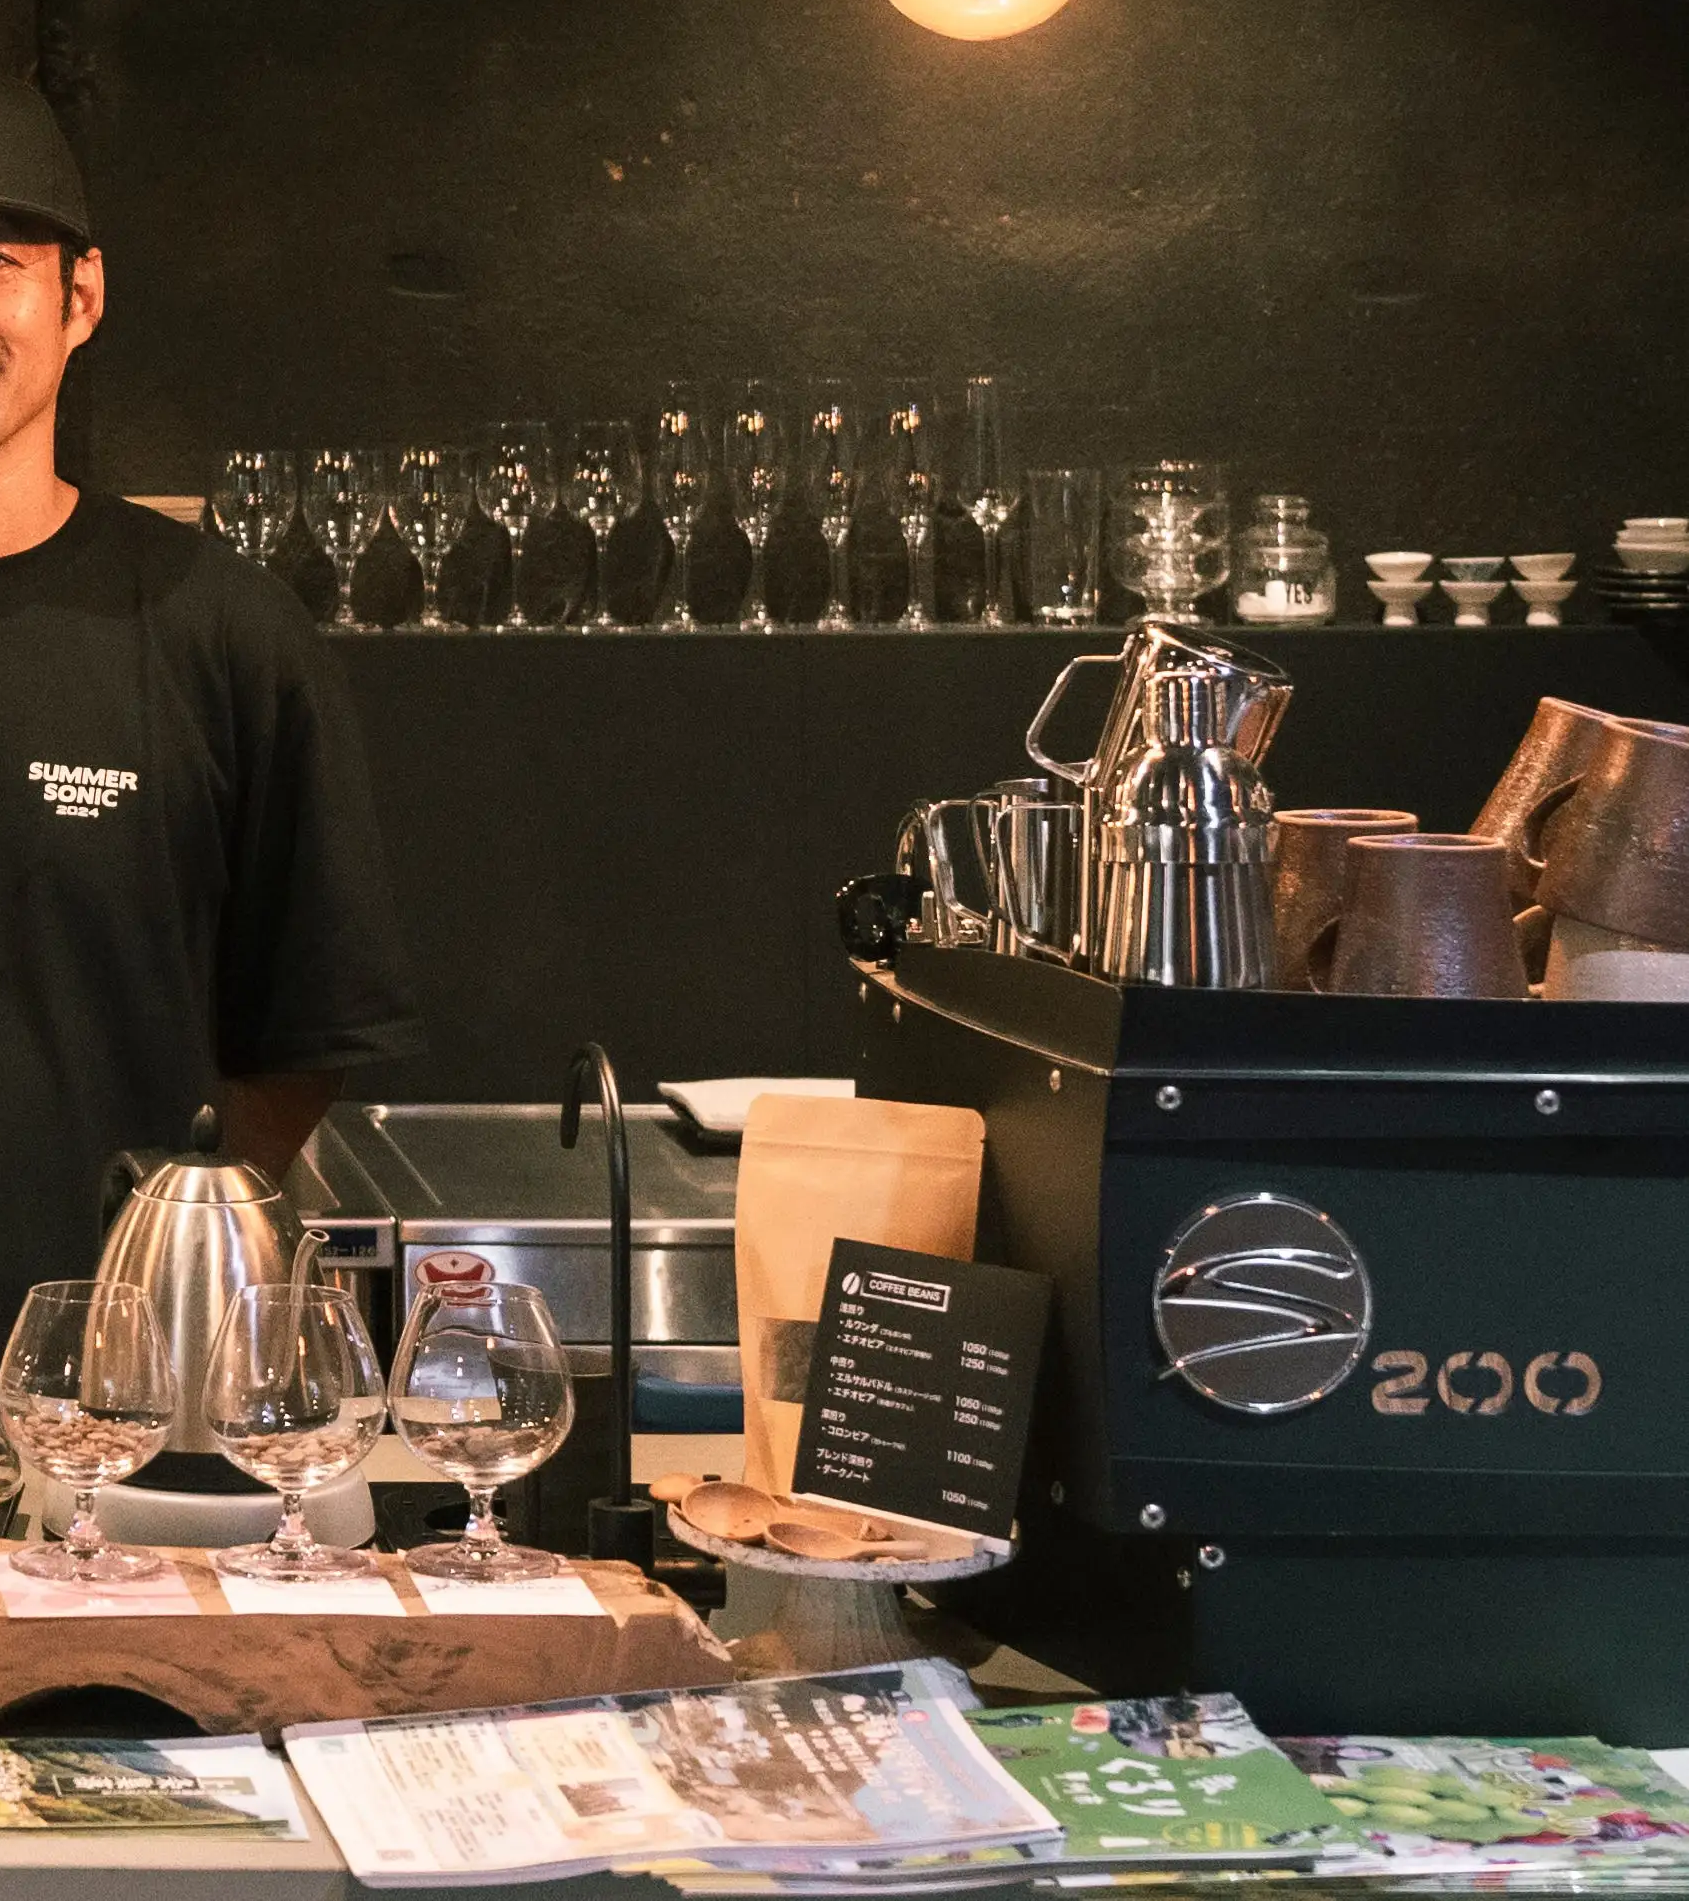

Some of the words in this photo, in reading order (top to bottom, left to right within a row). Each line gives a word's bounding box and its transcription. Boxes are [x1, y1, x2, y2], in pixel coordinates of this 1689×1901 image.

[1286, 583, 1313, 604] YES
[28, 761, 138, 791] SUMMER
[43, 782, 119, 807] SONIC
[55, 804, 99, 818] 2024
[869, 1279, 906, 1297] COFFEE
[907, 1284, 942, 1302] BEANS
[960, 1356, 986, 1371] 1250
[1372, 1350, 1602, 1416] 200
[946, 1450, 971, 1465] 1100
